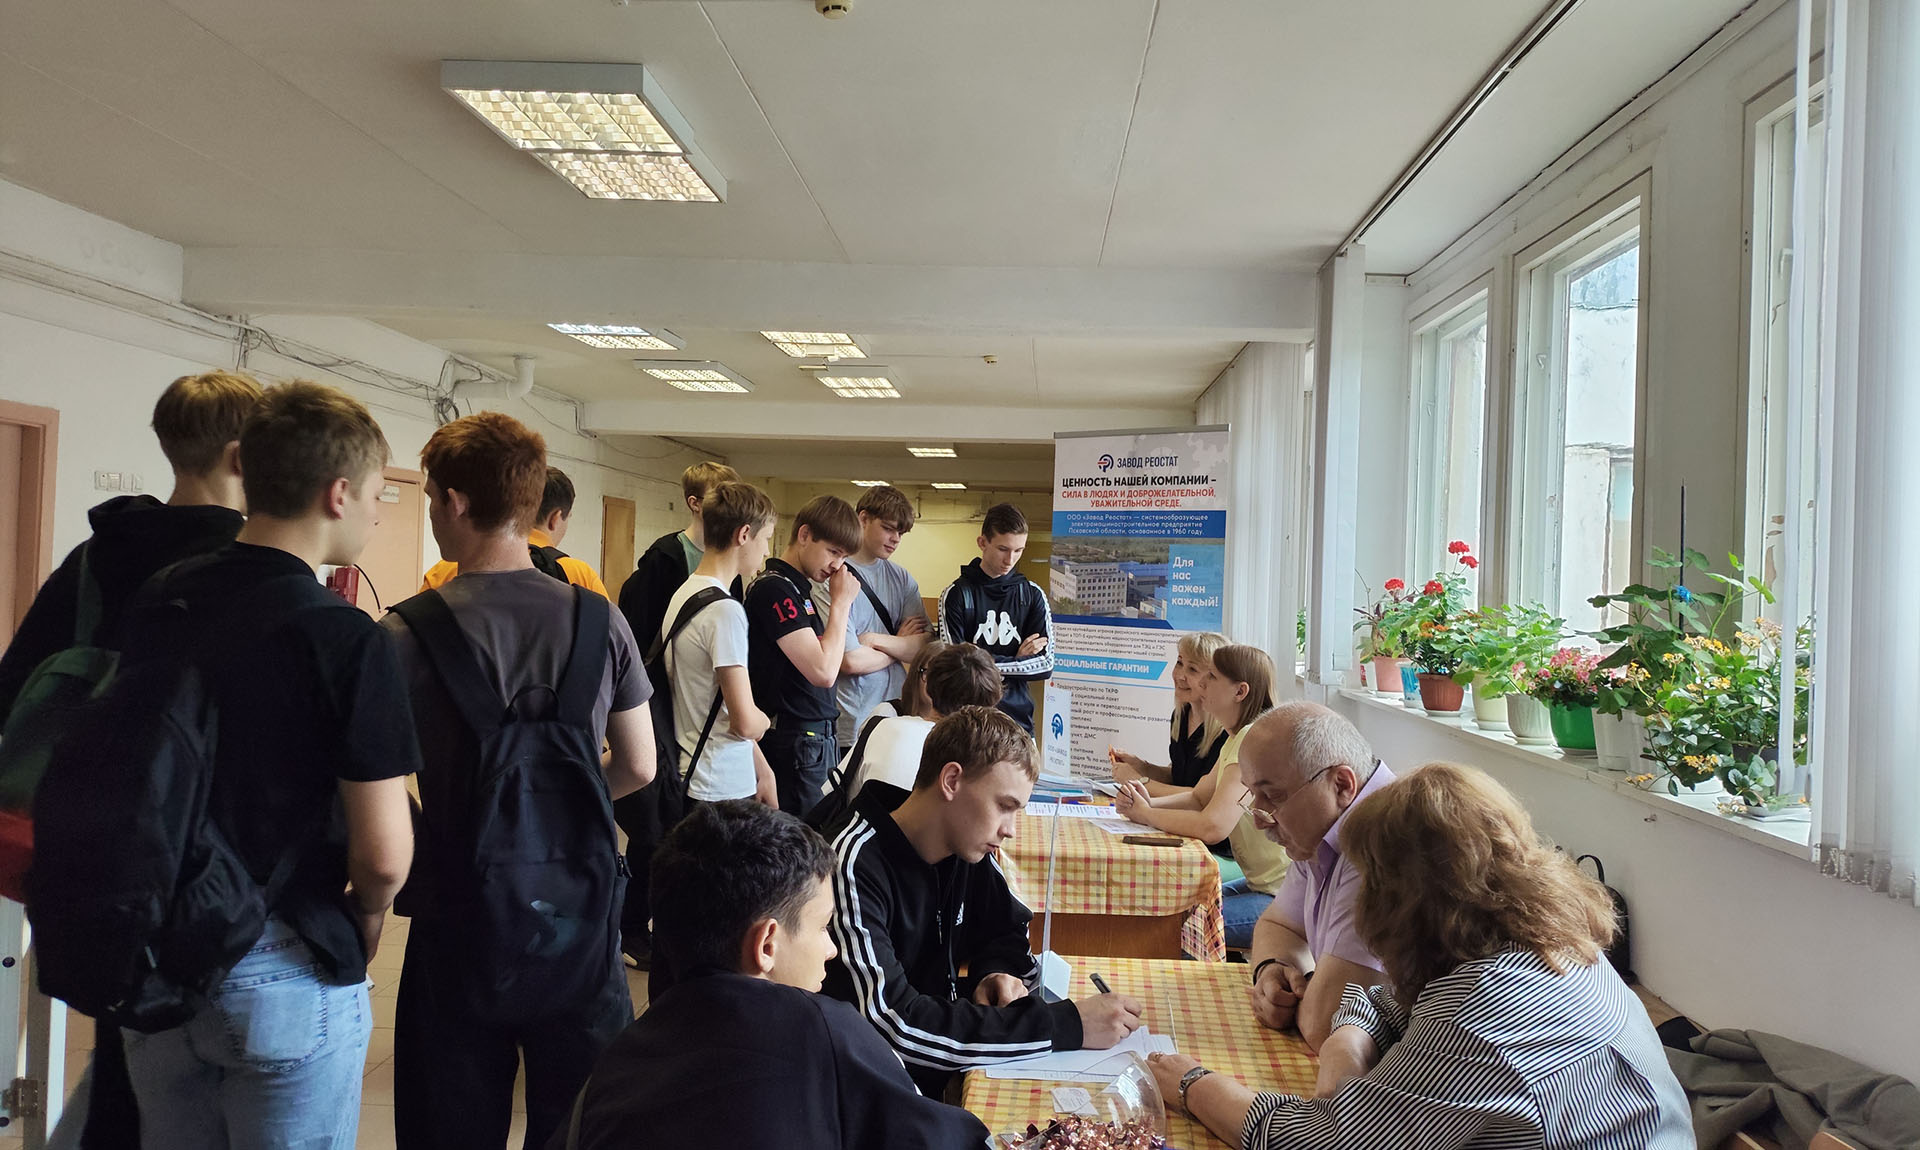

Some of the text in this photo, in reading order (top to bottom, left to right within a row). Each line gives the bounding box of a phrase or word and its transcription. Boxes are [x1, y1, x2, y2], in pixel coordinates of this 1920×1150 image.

[1117, 456, 1178, 469] ЗАВОД РЕОСТАТ
[1062, 477, 1112, 488] ЦЕННОСТЬ
[1114, 474, 1149, 487] НАШЕЙ
[1150, 475, 1209, 486] КОМПАНИИ
[1061, 487, 1216, 499] СИЛА В ЛЮДЯХ И ДОБРОЖЕЛАТЕЛЬНОЙ,
[1090, 499, 1182, 508] УВАЖИТЕЛЬНОЙ СРЕДЕ.
[1173, 556, 1194, 568] Для
[1172, 572, 1191, 580] нас
[1172, 584, 1206, 593] важен
[1172, 596, 1218, 608] каждый!
[772, 597, 798, 624] 13
[1054, 658, 1108, 670] СОЦИАЛЬНЫЕ
[1108, 662, 1150, 674] ГАРАНТИИ
